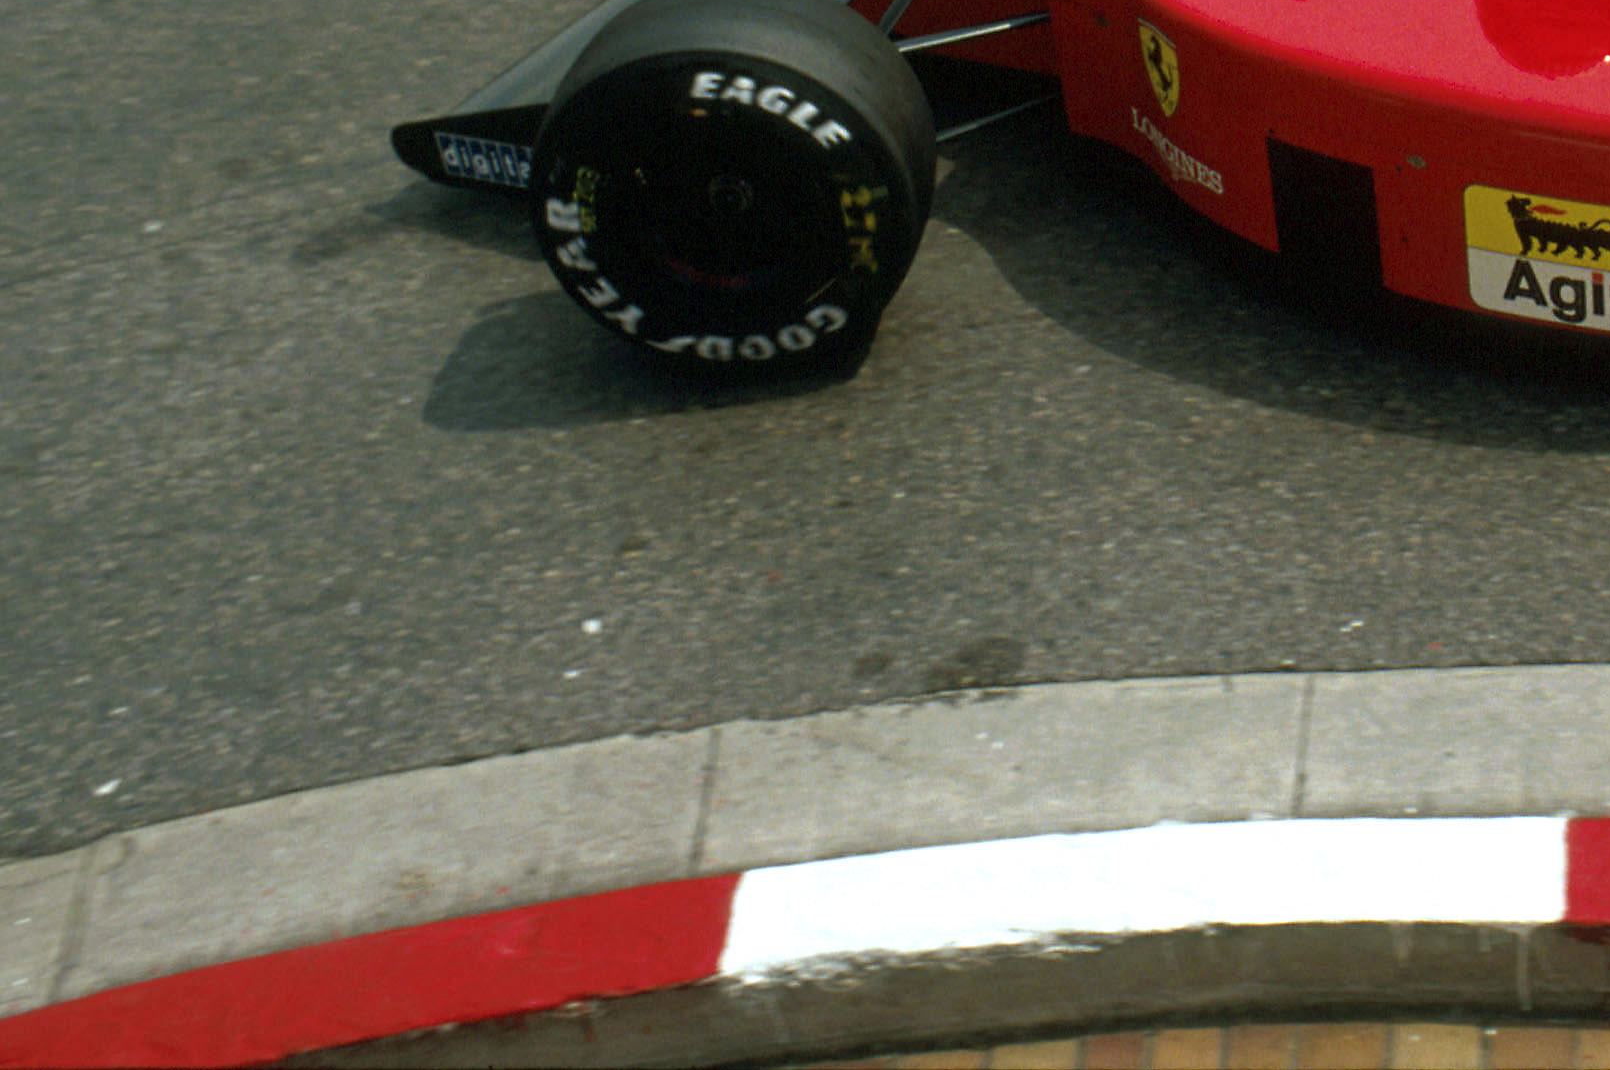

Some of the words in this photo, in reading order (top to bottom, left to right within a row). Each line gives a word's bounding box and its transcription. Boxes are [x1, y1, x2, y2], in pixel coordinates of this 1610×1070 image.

[690, 70, 853, 152] EAGLE
[441, 134, 532, 180] digita
[544, 197, 850, 363] GOODYEAR
